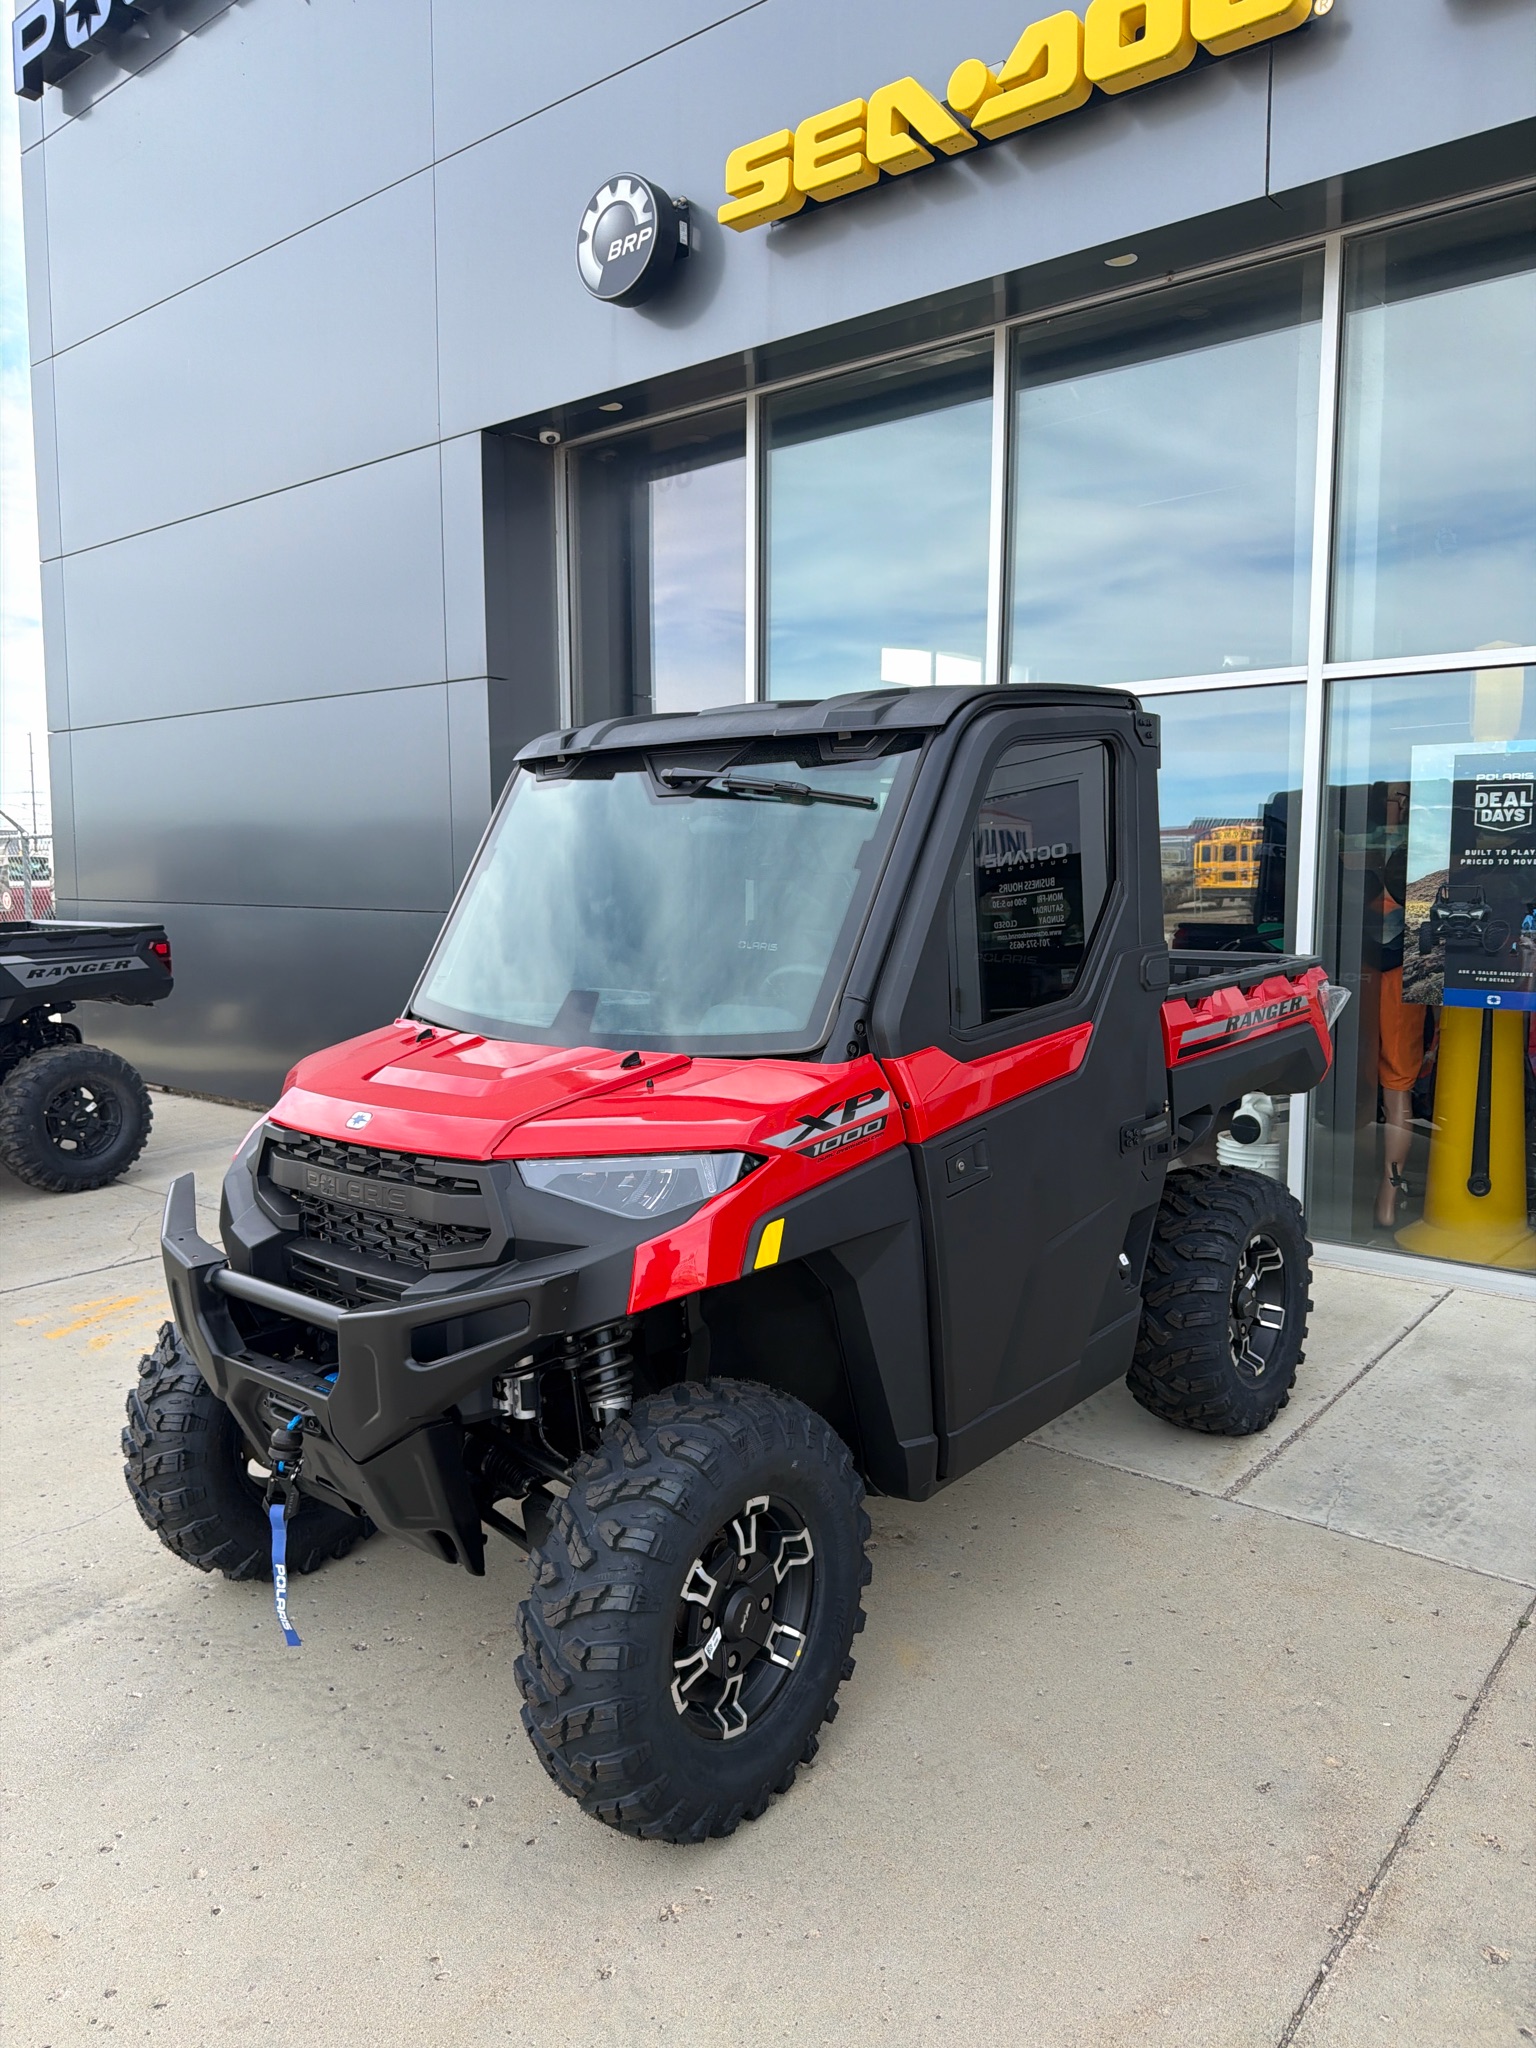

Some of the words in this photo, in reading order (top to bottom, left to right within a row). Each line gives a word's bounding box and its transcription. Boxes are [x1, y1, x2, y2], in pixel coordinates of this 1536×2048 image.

[607, 226, 652, 262] BRP
[1476, 772, 1534, 781] POLARIS
[1475, 791, 1534, 808] DEAL
[1481, 808, 1525, 822] DAYS
[1460, 858, 1494, 866] PRICED
[1498, 858, 1510, 866] TO
[26, 959, 132, 979] RANGER
[1225, 996, 1303, 1033] RANGER
[787, 1087, 885, 1146] XP
[813, 1118, 883, 1157] 1000
[307, 1168, 407, 1212] POLARIS
[275, 1563, 292, 1631] POLARIS
